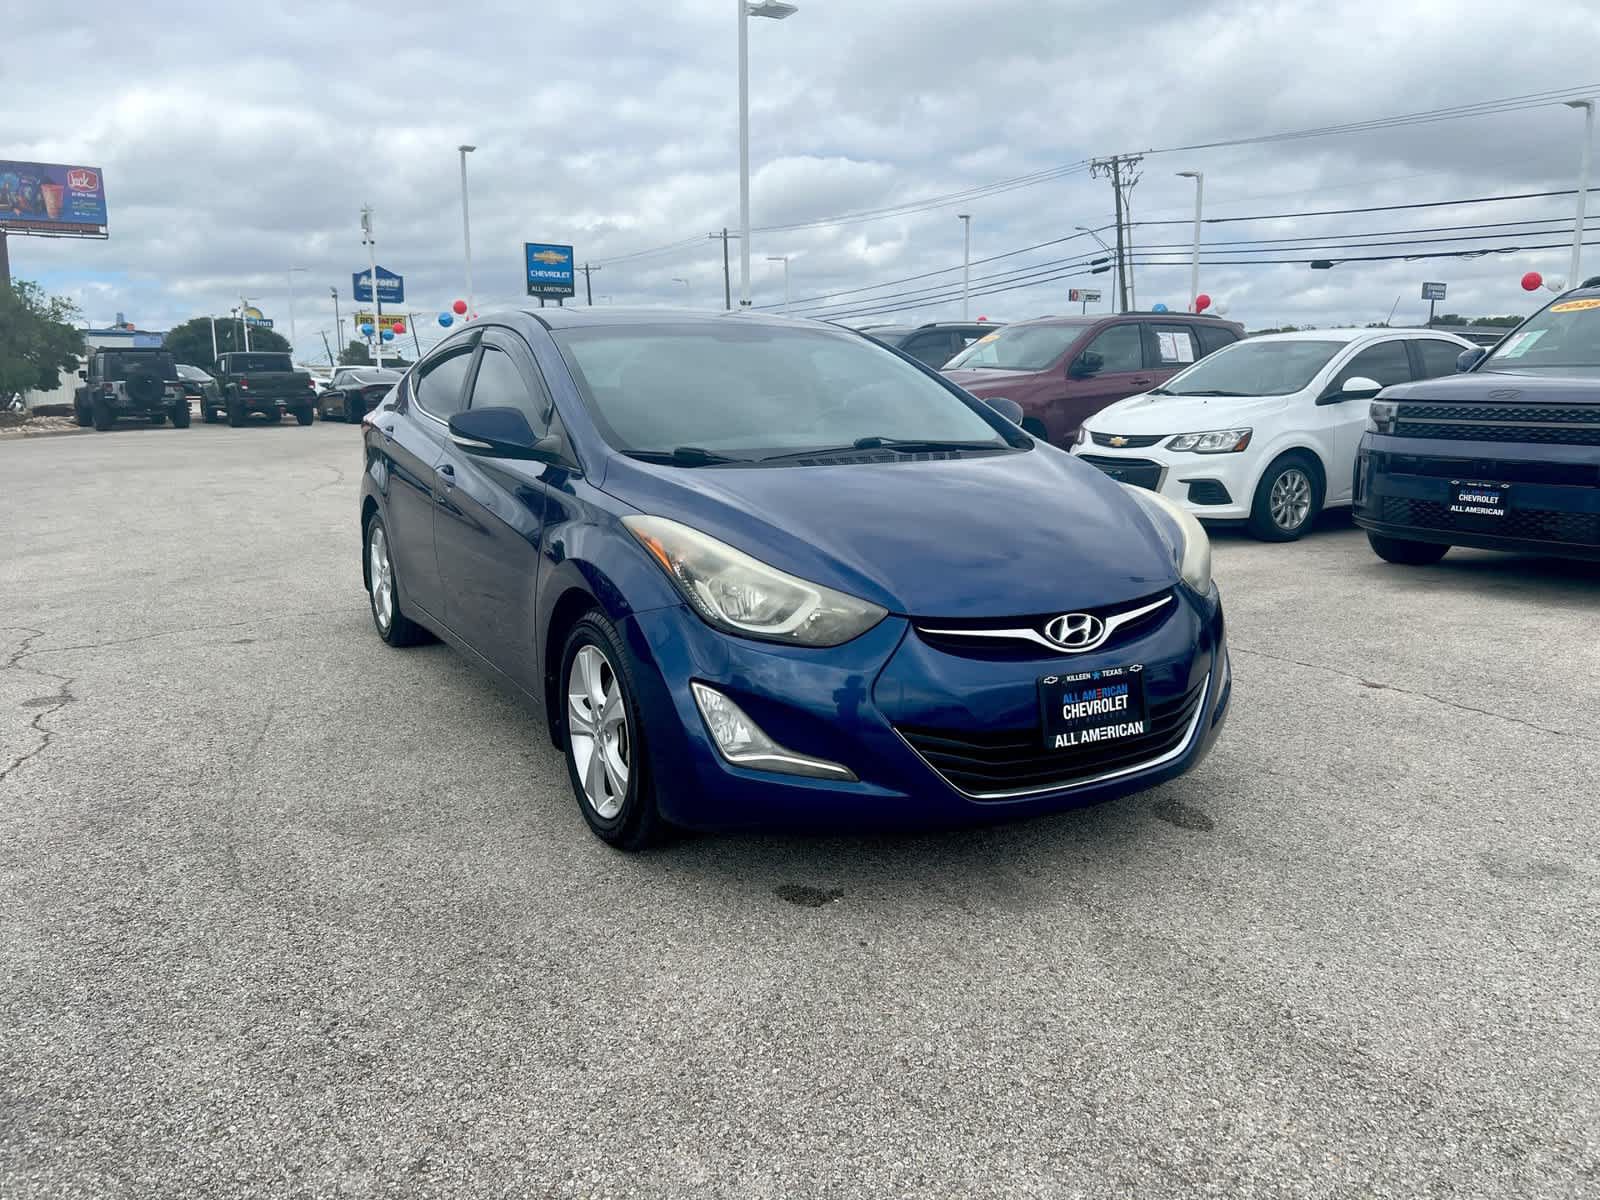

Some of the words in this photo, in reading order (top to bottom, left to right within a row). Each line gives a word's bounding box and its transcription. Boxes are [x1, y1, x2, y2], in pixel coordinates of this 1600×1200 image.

[530, 270, 570, 278] CHEVROLET
[1458, 493, 1499, 504] CHEVROLET
[1450, 504, 1464, 512] ALL
[1465, 506, 1504, 516] AMERICAN
[1066, 672, 1091, 682] KILLEEN
[1102, 668, 1123, 677] TEXAS
[1063, 692, 1080, 704] ALL
[1082, 684, 1128, 702] AMERICAN
[1063, 694, 1128, 720] CHEVROLET
[1055, 732, 1079, 748] ALL
[1081, 721, 1144, 744] AMERICAN
